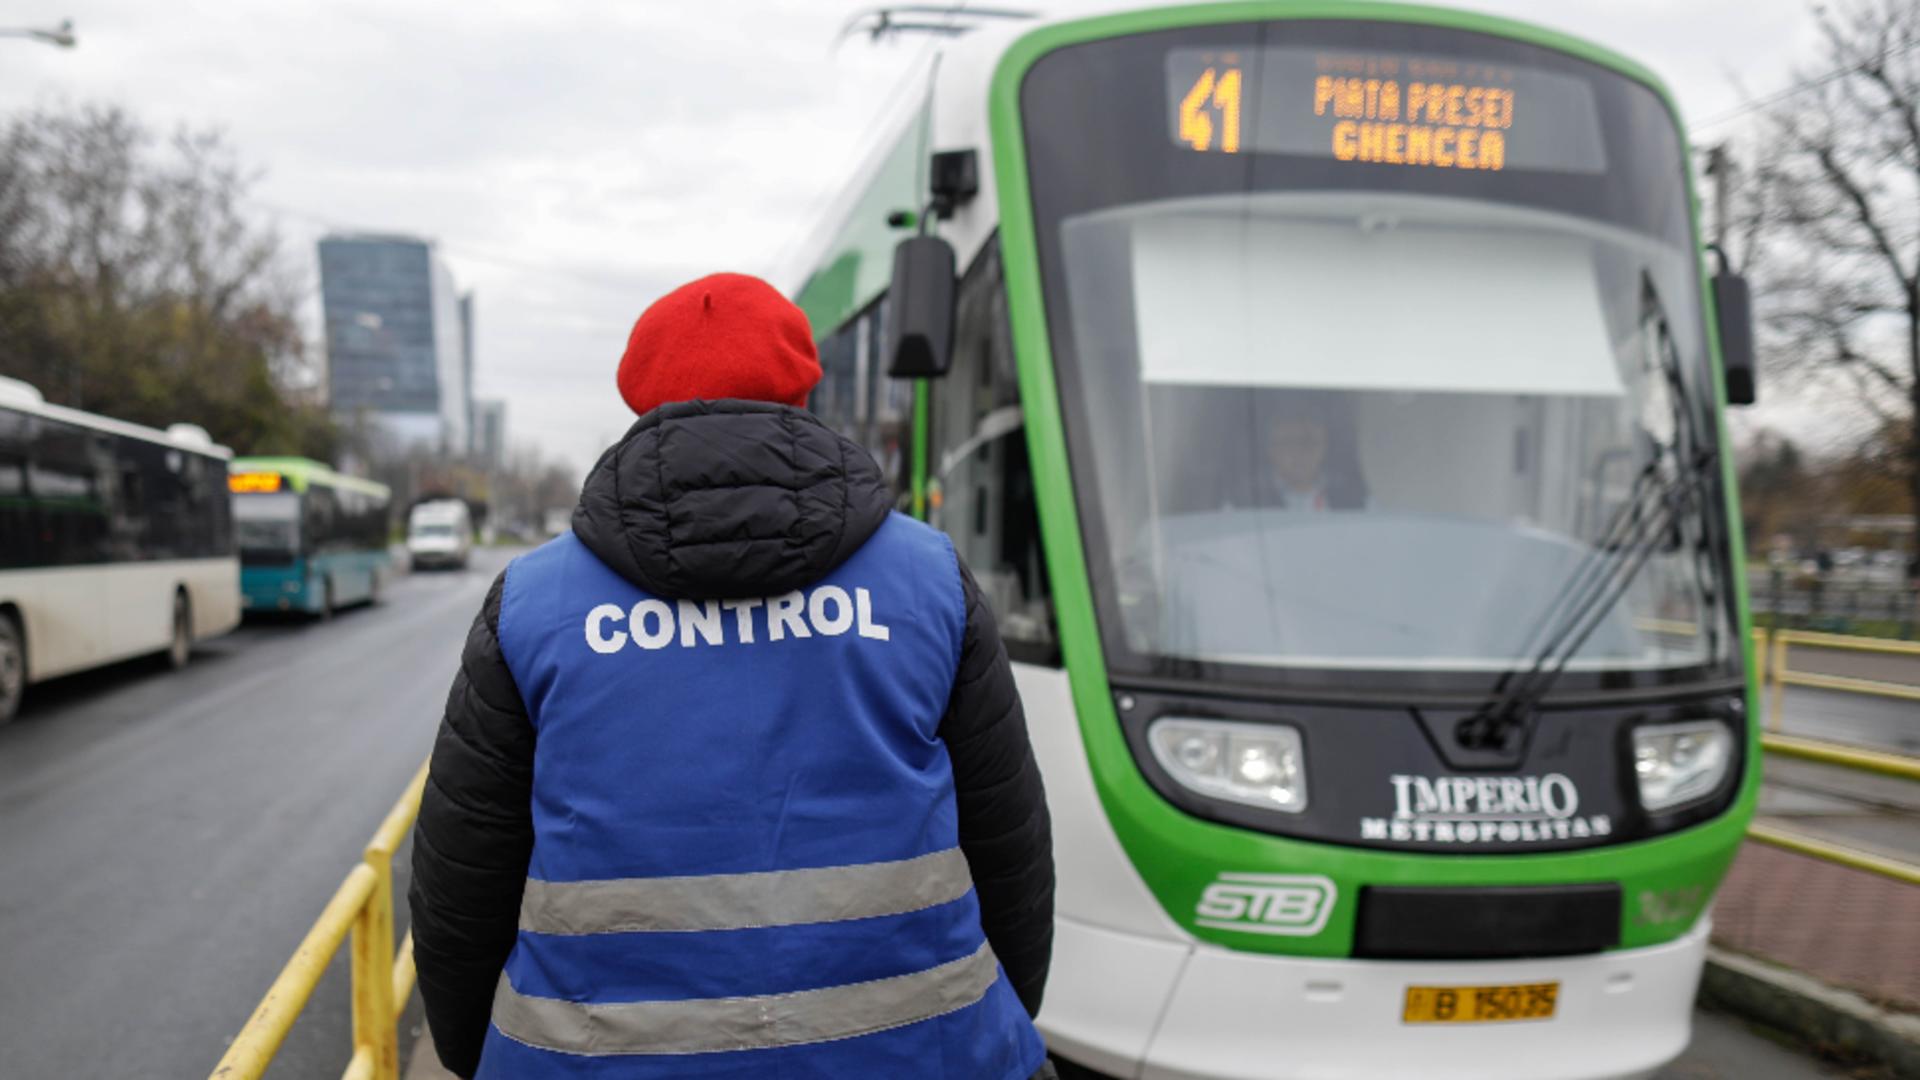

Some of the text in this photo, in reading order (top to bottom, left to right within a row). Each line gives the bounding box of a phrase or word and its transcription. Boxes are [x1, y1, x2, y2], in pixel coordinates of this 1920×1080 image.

[1179, 67, 1242, 153] 41
[1332, 120, 1505, 170] GHENCEA
[585, 585, 890, 654] CONTROL
[1390, 773, 1579, 819] IMPERIO
[1196, 882, 1322, 922] STB
